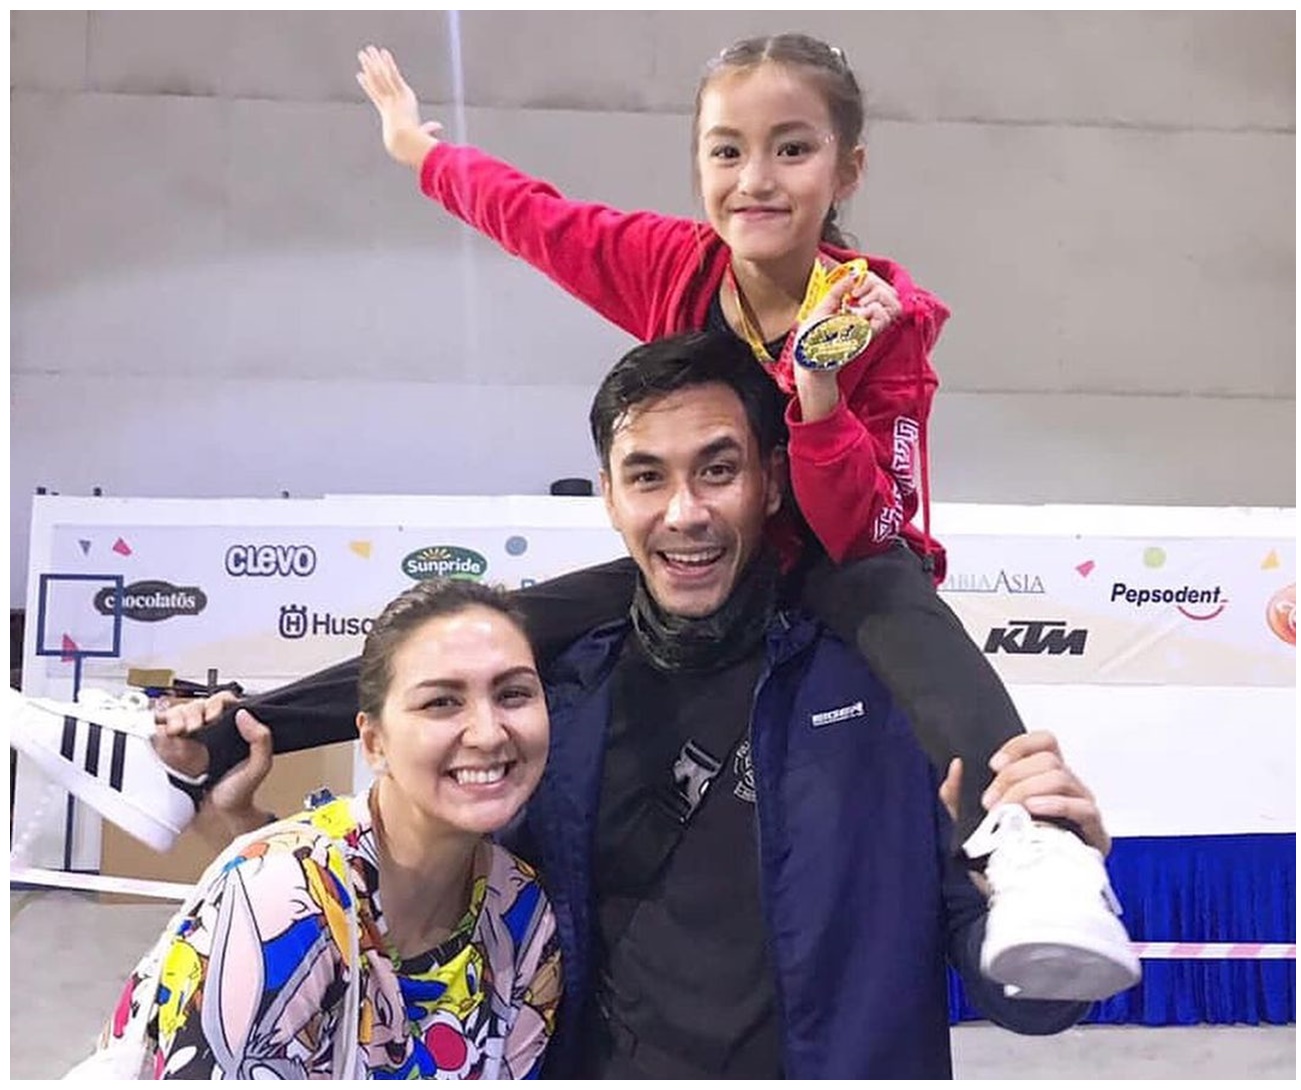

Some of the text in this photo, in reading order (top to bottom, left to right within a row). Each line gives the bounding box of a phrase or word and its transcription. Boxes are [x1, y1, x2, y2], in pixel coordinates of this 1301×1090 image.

[407, 557, 481, 576] Sunpride
[1111, 583, 1222, 606] Pepsodent
[983, 620, 1088, 656] KTM
